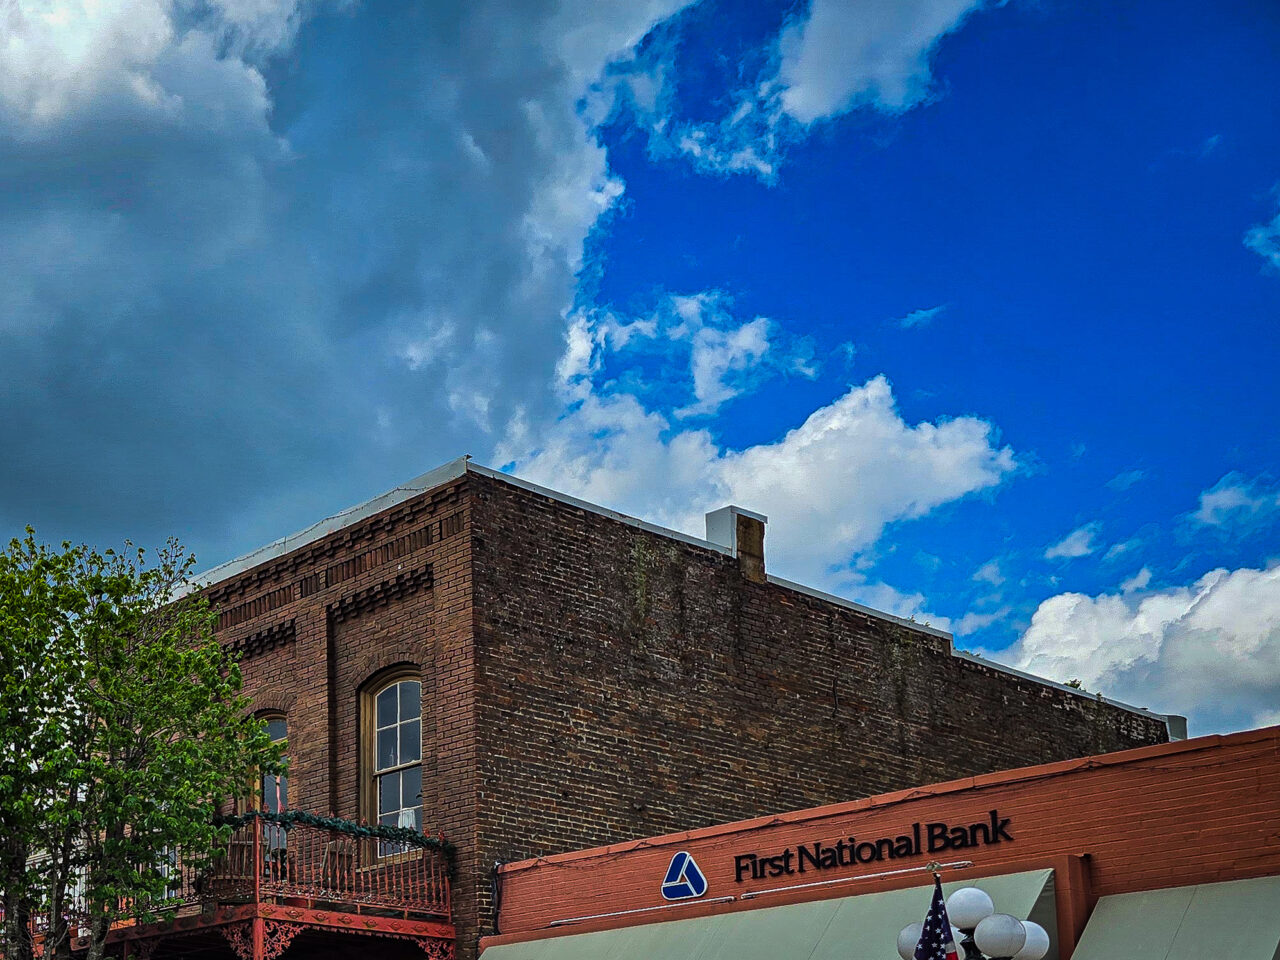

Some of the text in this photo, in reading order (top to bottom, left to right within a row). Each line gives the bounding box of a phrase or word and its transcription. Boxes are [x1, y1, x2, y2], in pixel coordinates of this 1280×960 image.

[734, 809, 1014, 882] First National Bank
